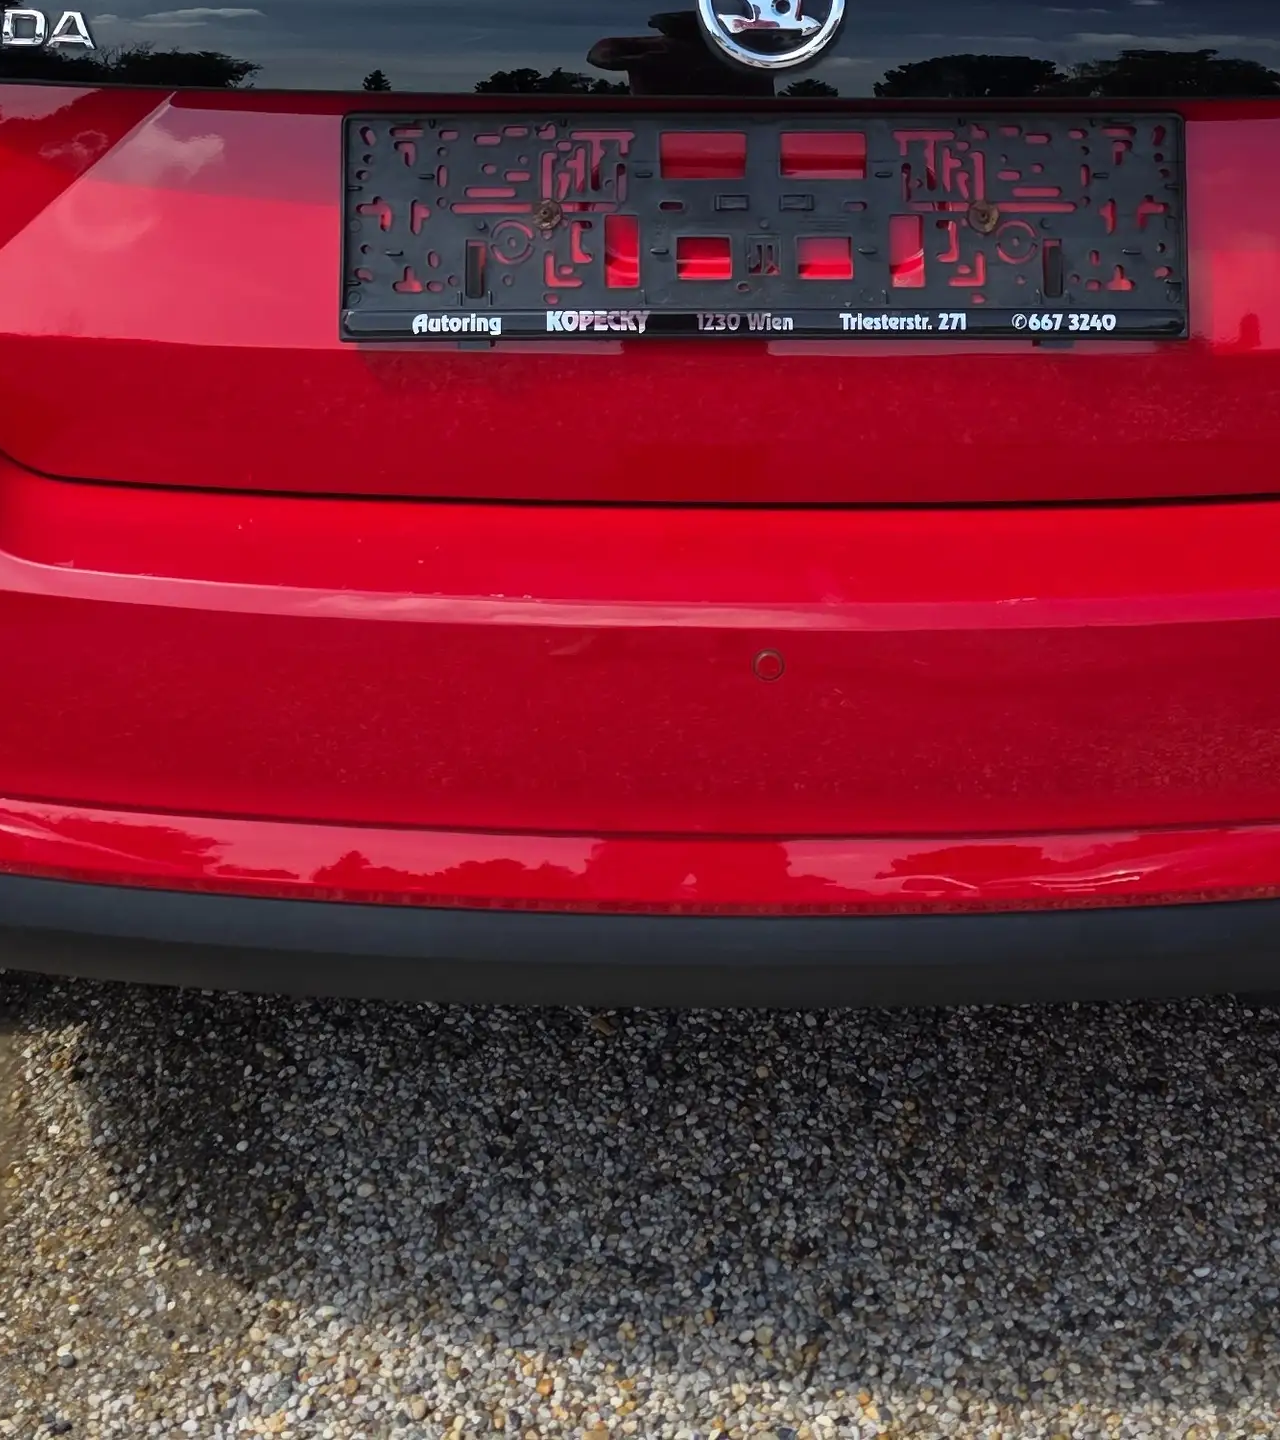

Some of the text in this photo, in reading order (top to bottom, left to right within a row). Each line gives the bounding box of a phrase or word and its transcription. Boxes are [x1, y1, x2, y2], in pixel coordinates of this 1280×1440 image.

[412, 313, 502, 336] Autoring
[546, 310, 651, 333] KOPECKY
[696, 312, 740, 331] 1230
[747, 312, 793, 331] Wien
[839, 312, 933, 331] Triesterstr.
[938, 312, 967, 330] 271
[1068, 313, 1117, 330] 3240
